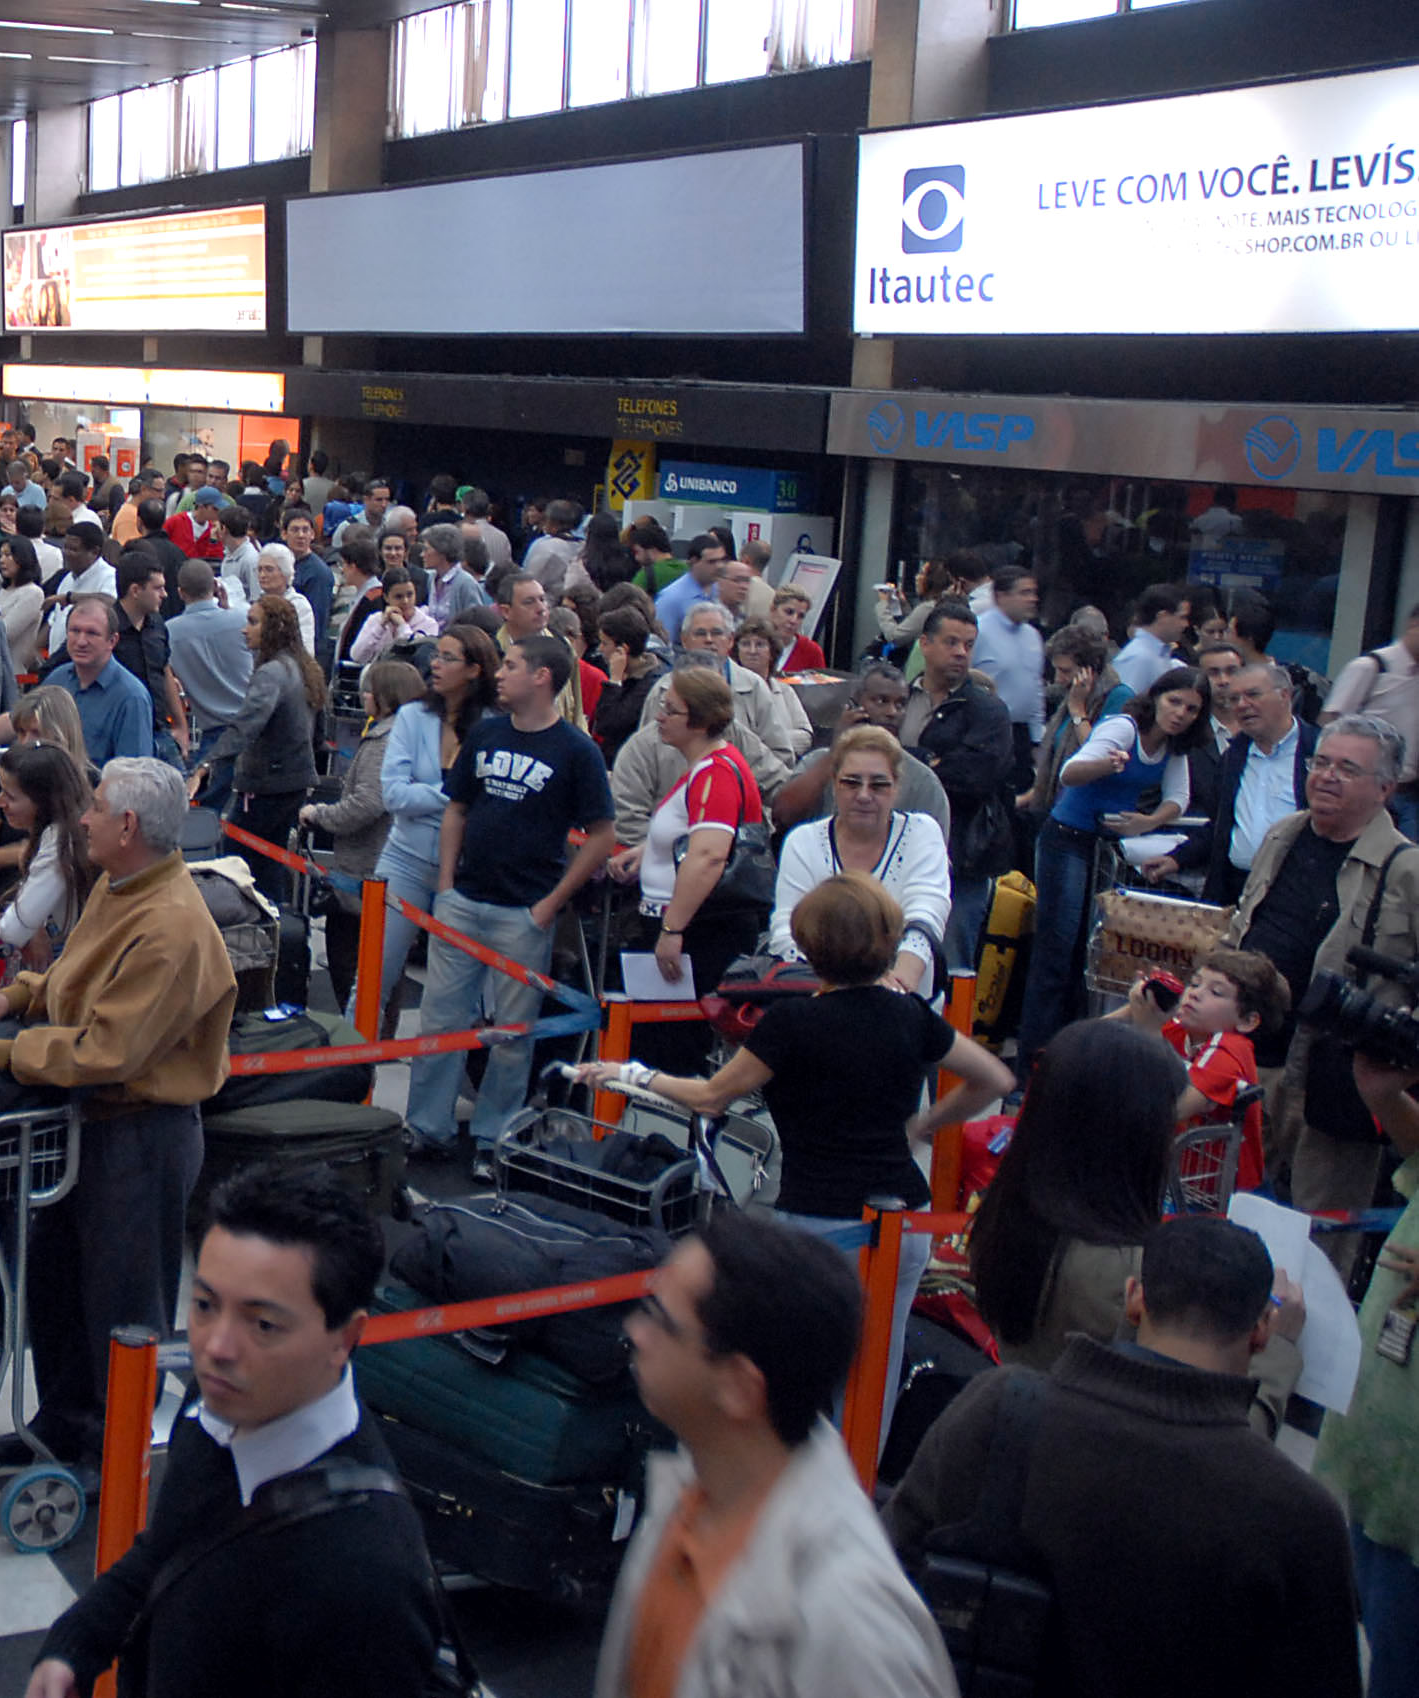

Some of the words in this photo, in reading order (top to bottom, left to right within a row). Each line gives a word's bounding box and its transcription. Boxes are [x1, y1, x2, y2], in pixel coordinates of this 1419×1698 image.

[1039, 178, 1106, 209] LEVE
[1117, 172, 1187, 205] COM
[1198, 154, 1300, 199] VOCÊ.
[1267, 208, 1311, 226] MAIS
[1370, 230, 1399, 248] OU
[869, 265, 995, 304] Itautec
[617, 397, 678, 416] TELEFONES
[914, 411, 1036, 452] VASP
[679, 476, 738, 495] UNIBANCO
[475, 750, 554, 793] LOVE
